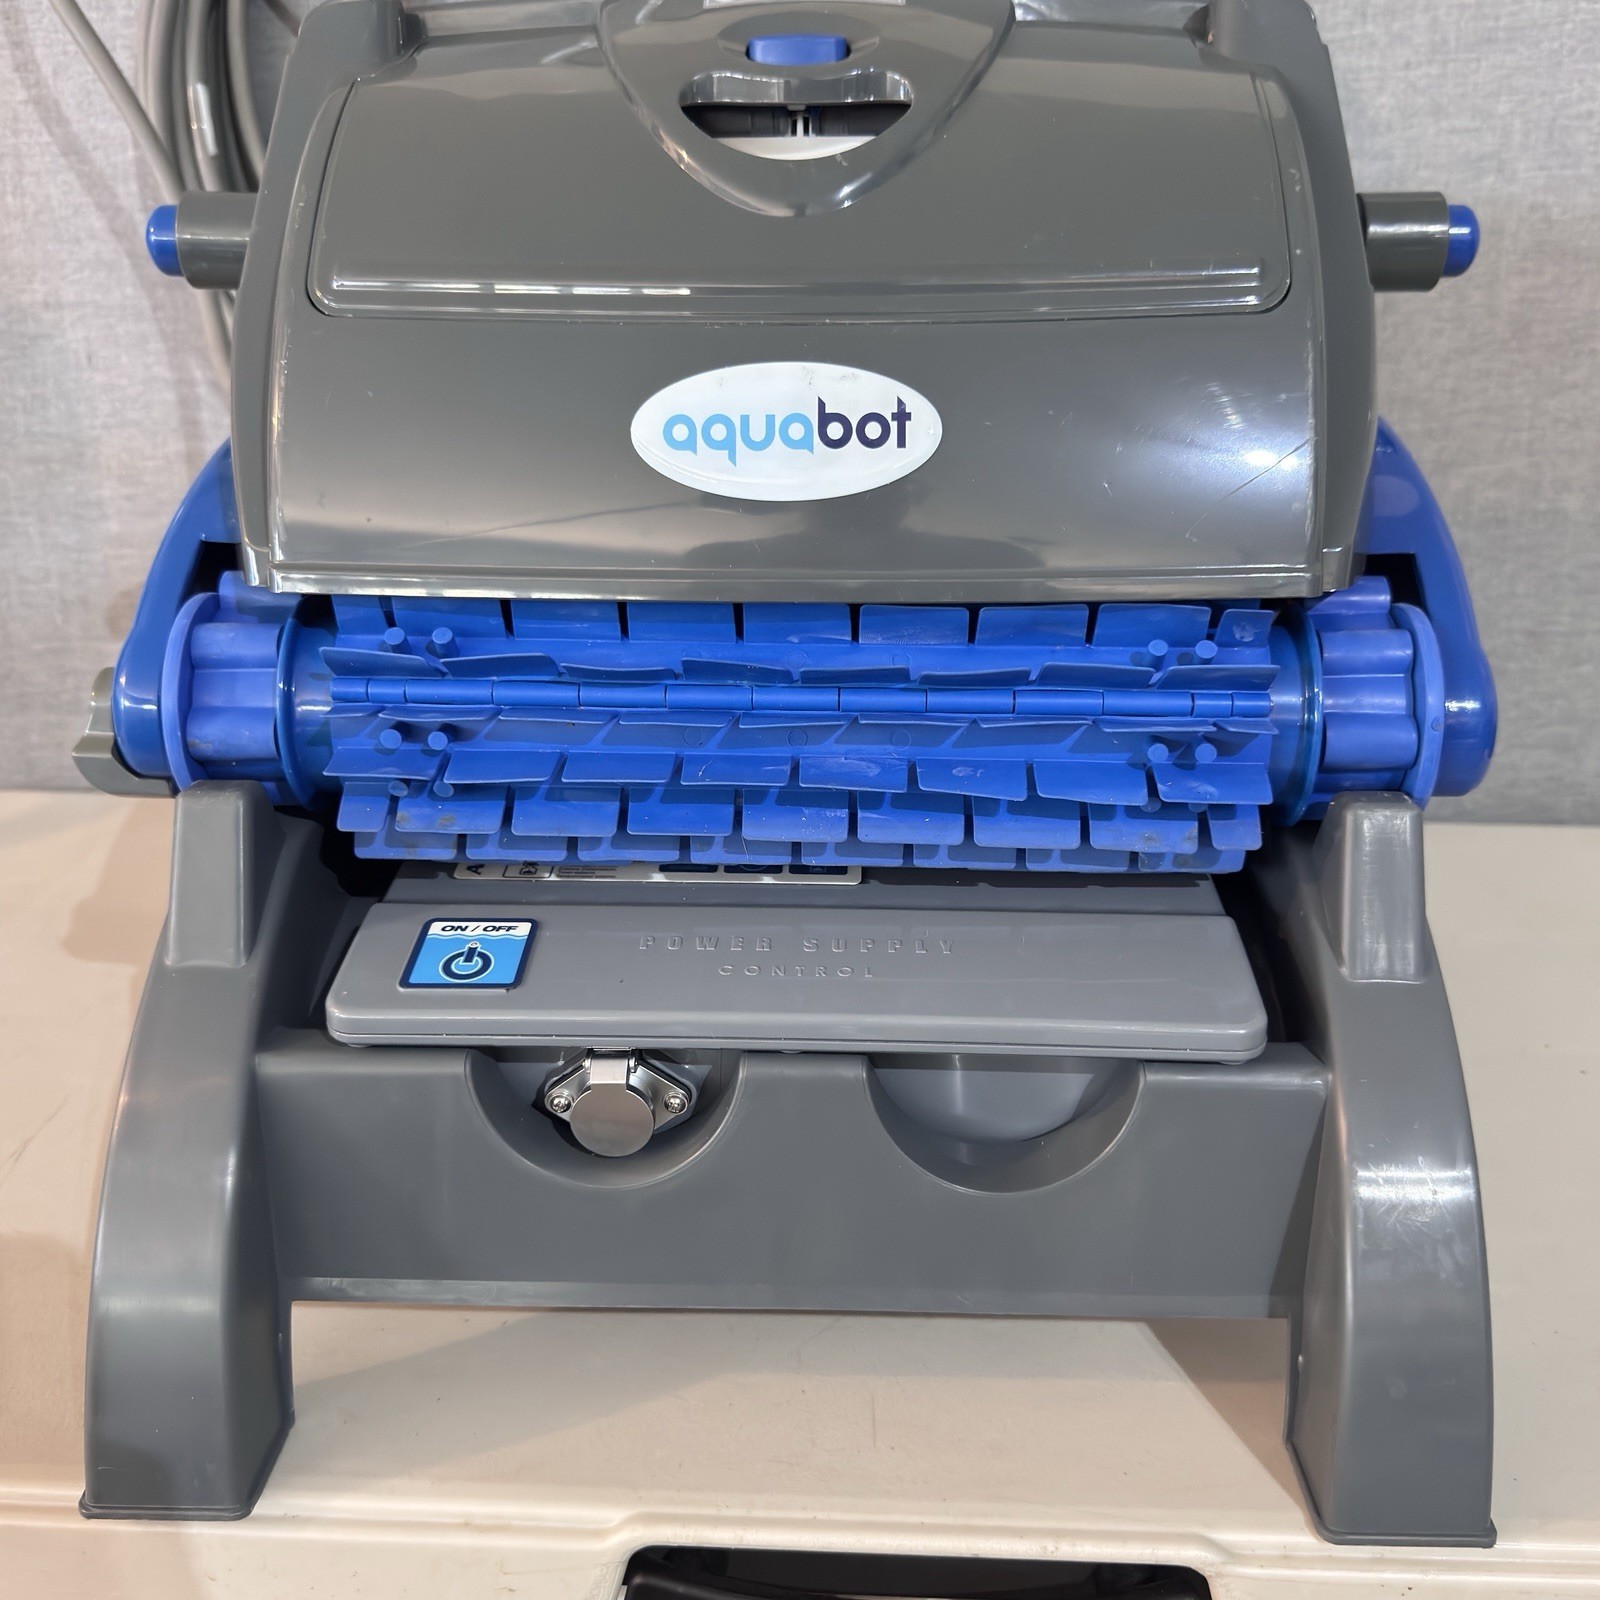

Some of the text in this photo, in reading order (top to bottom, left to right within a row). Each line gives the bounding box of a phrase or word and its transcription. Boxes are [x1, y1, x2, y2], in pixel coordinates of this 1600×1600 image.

[662, 395, 912, 468] aquabot
[638, 935, 956, 955] POWER SUPPLY
[717, 964, 874, 978] CONTROL
